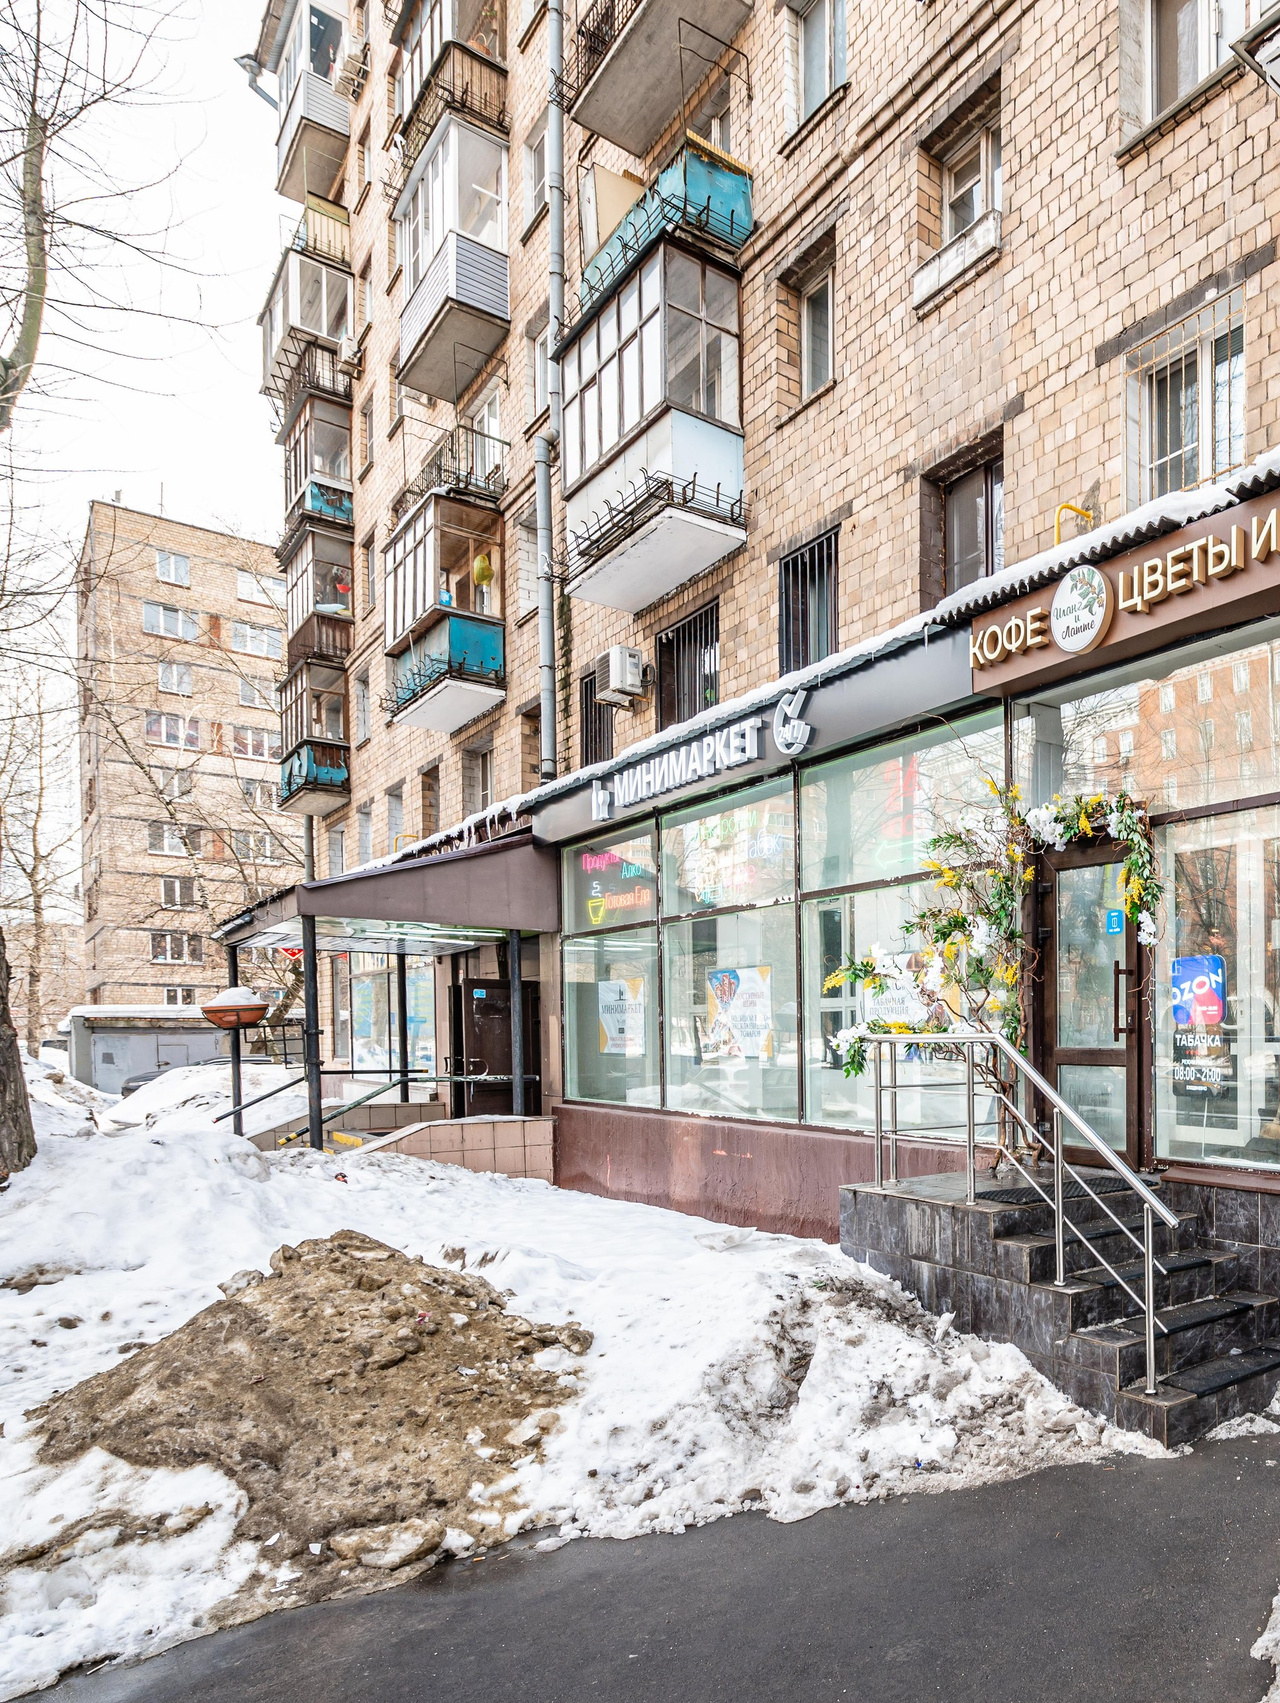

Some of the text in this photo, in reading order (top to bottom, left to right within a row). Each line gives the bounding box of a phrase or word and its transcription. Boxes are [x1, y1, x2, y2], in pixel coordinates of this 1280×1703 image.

[1118, 524, 1244, 614] ЦВЕТЫ
[969, 606, 1049, 669] КОФЕ
[1061, 619, 1096, 640] Латте
[613, 717, 762, 808] МИНИМАРКЕТ
[621, 861, 643, 879] Алко
[605, 885, 651, 910] Готовая Еда
[1172, 968, 1223, 1006] OZON
[601, 1003, 642, 1015] МИНИМАРКЕТ
[1175, 1034, 1221, 1048] ТАБАЧКА
[1174, 1066, 1195, 1081] 08:00
[1201, 1067, 1221, 1082] 21:00
